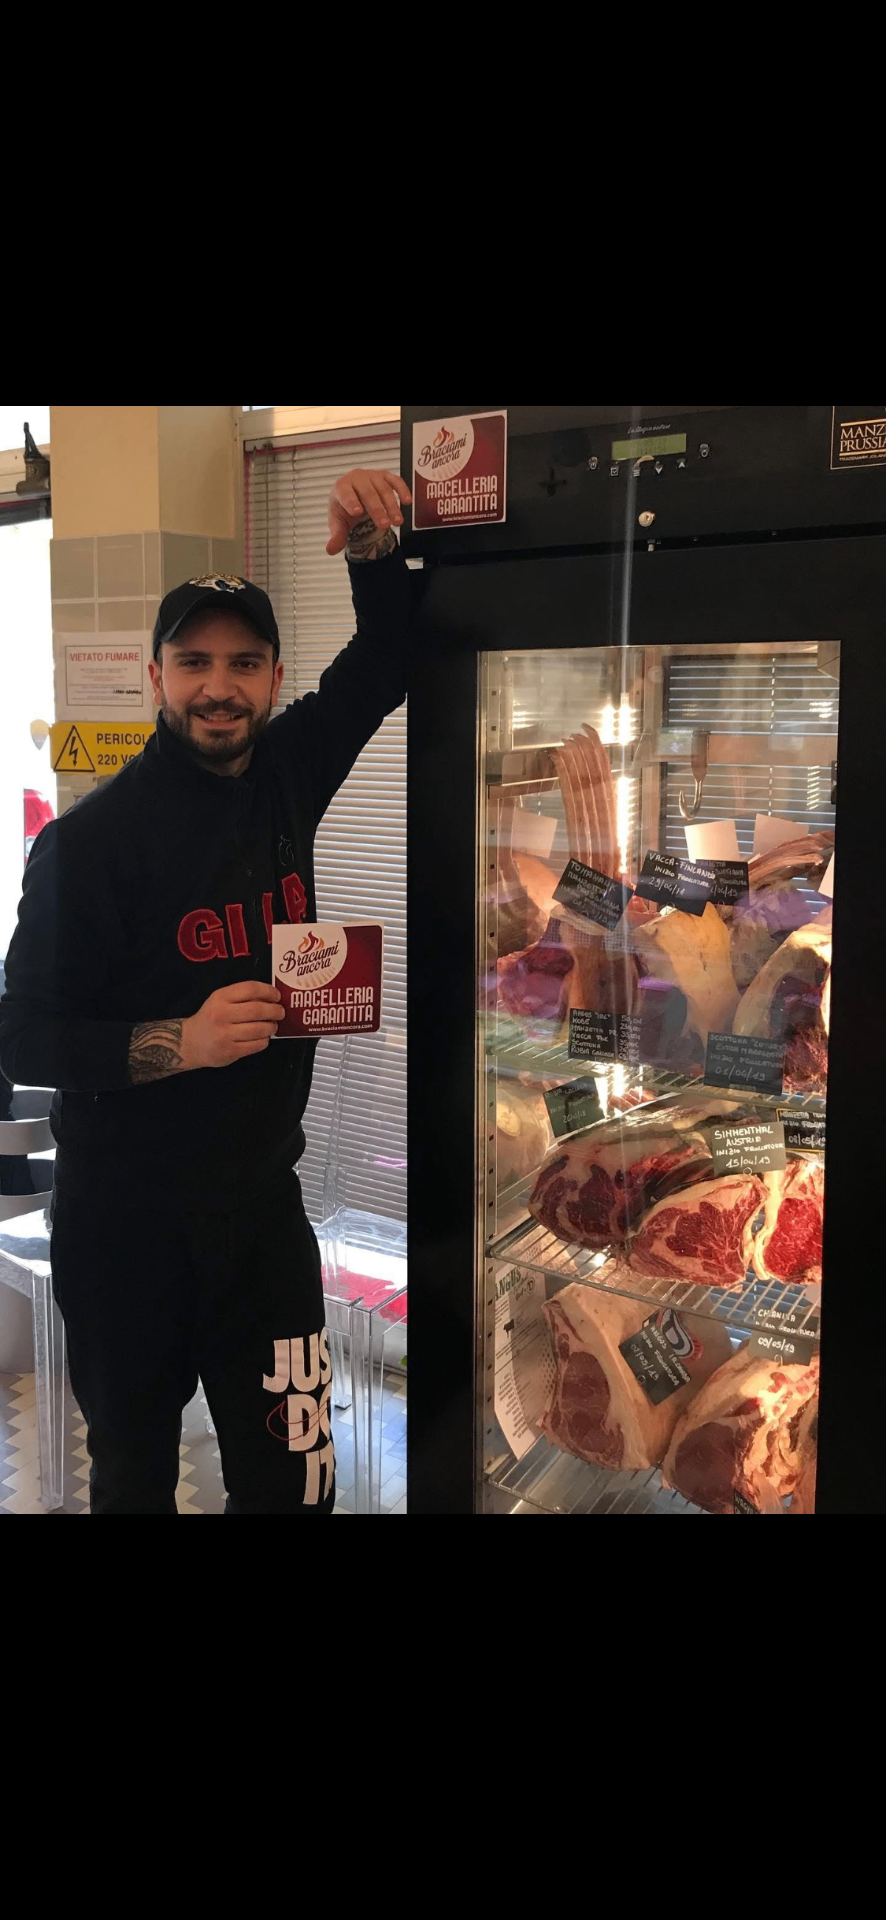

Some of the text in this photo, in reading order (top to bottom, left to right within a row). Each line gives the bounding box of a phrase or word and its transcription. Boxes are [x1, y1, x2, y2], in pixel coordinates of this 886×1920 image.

[417, 432, 467, 467] Braciami
[431, 449, 461, 469] ancora
[426, 475, 498, 500] MACELLERIA
[437, 493, 498, 516] GARANTITA
[70, 652, 140, 662] VIETATO FUMARE
[97, 754, 118, 766] 220
[279, 939, 340, 973] Braciami
[297, 957, 332, 977] ancora
[290, 986, 374, 1008] MACELLERIA
[302, 1004, 374, 1025] GARANTITA
[308, 1023, 374, 1033] www.braciamiancora.com
[715, 1065, 766, 1081] 01/04/19
[714, 1125, 774, 1140] SIMMENTHAL
[726, 1136, 762, 1147] AUSTRIA
[757, 1337, 795, 1354] 09/05/19
